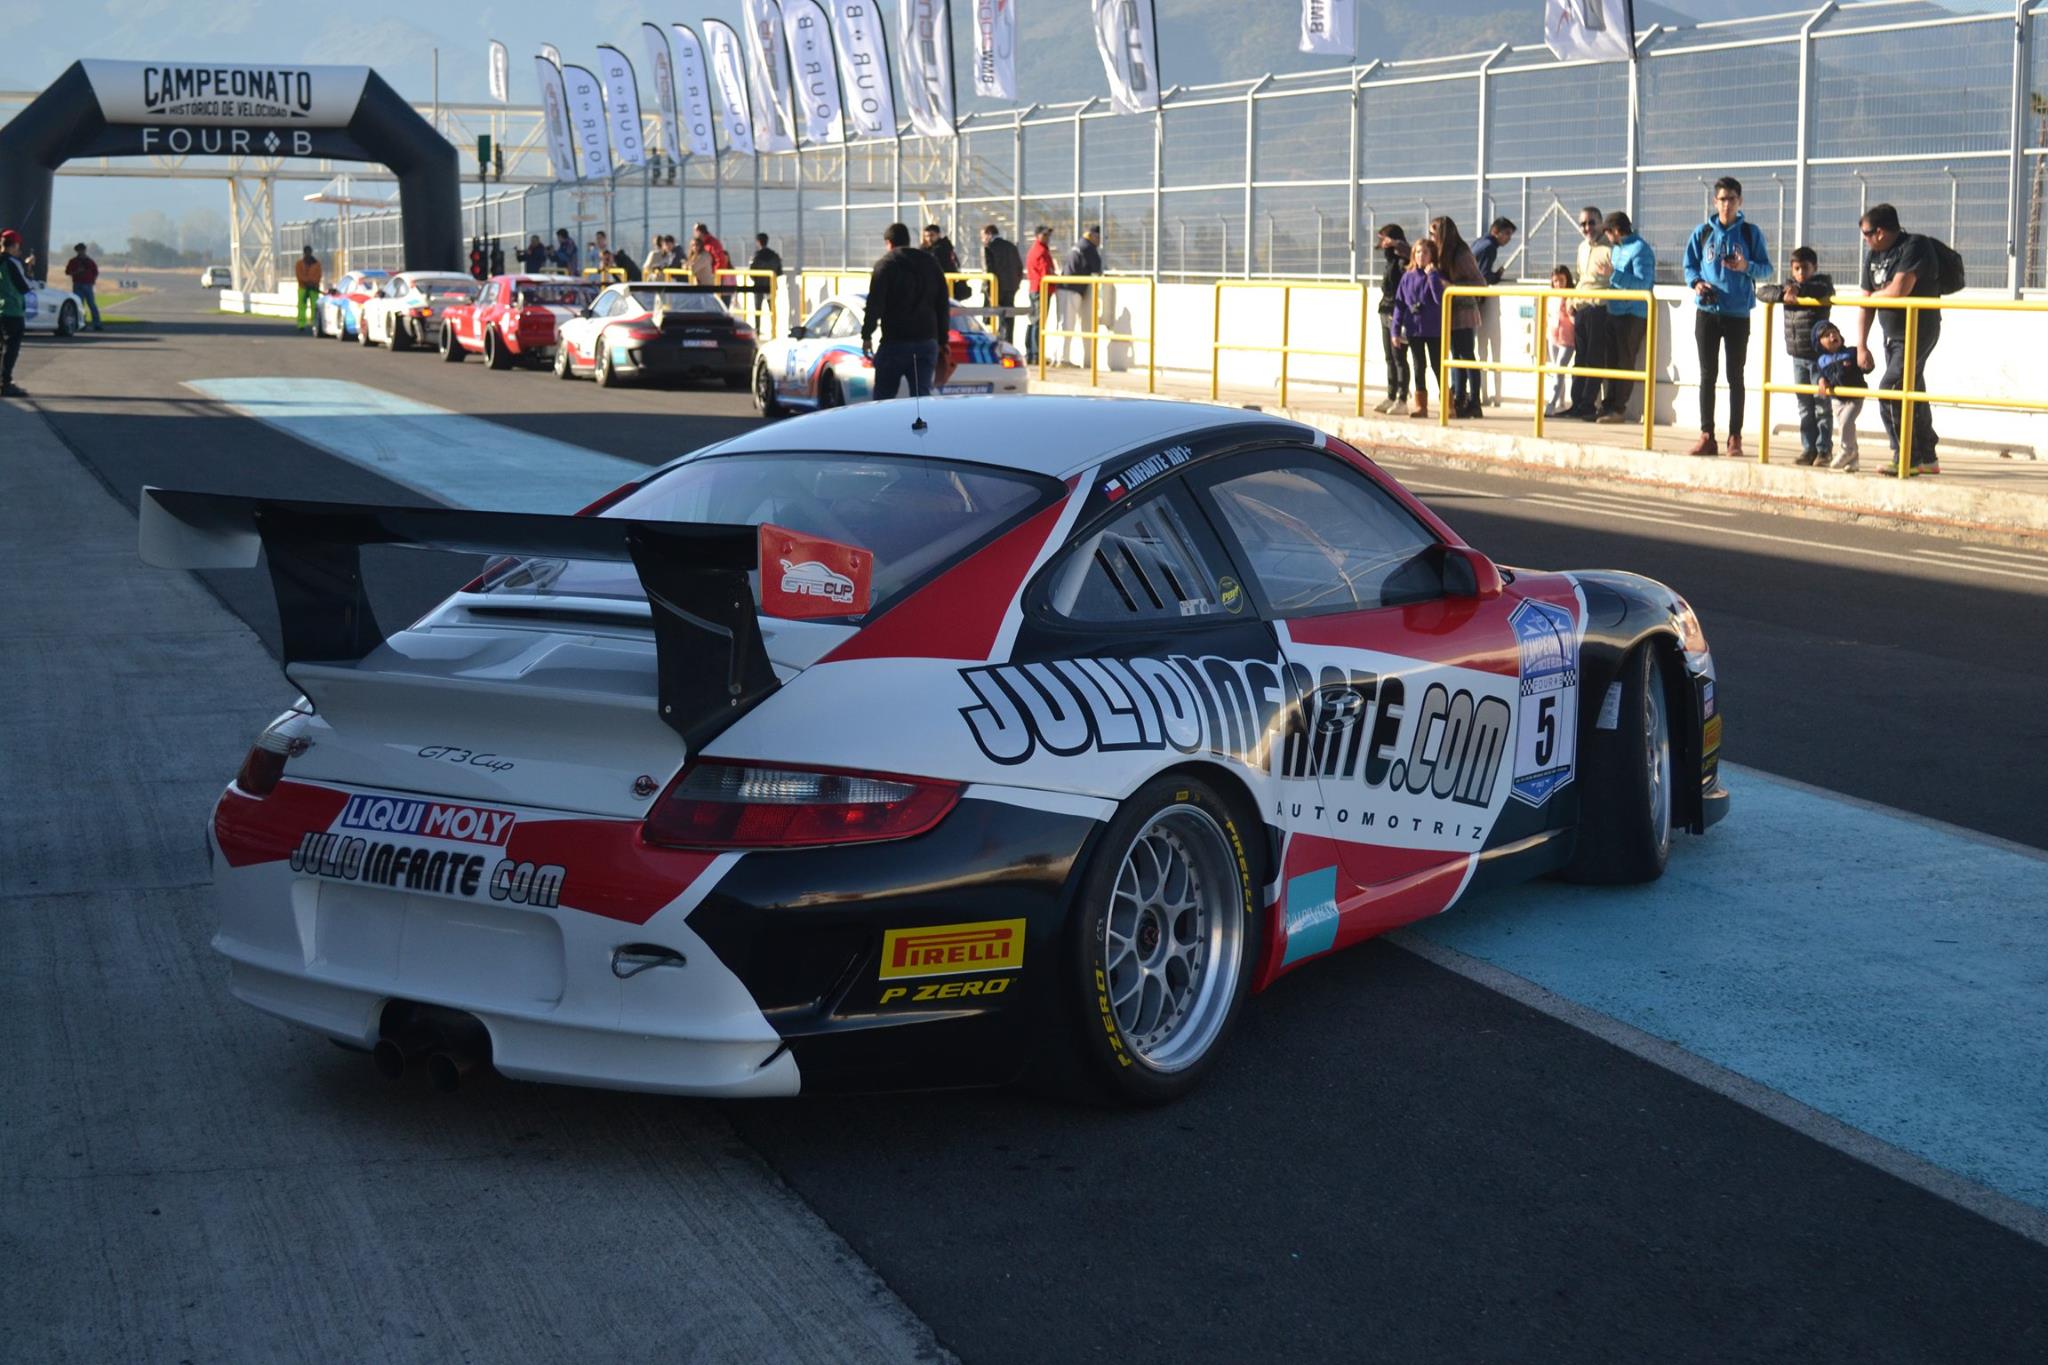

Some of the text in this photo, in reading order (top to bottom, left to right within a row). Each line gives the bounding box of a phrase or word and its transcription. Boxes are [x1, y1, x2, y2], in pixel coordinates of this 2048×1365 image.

[144, 67, 312, 112] CAMPEONATO
[221, 101, 234, 116] DE
[237, 101, 288, 118] VELOCIDAD
[142, 128, 312, 155] FOUR B
[1535, 696, 1556, 767] 5
[345, 796, 515, 843] LIQUI MOLY
[1276, 798, 1484, 841] AUTOMOTRIZ
[892, 928, 1013, 968] PIRELLI
[880, 978, 1010, 1004] P ZERO
